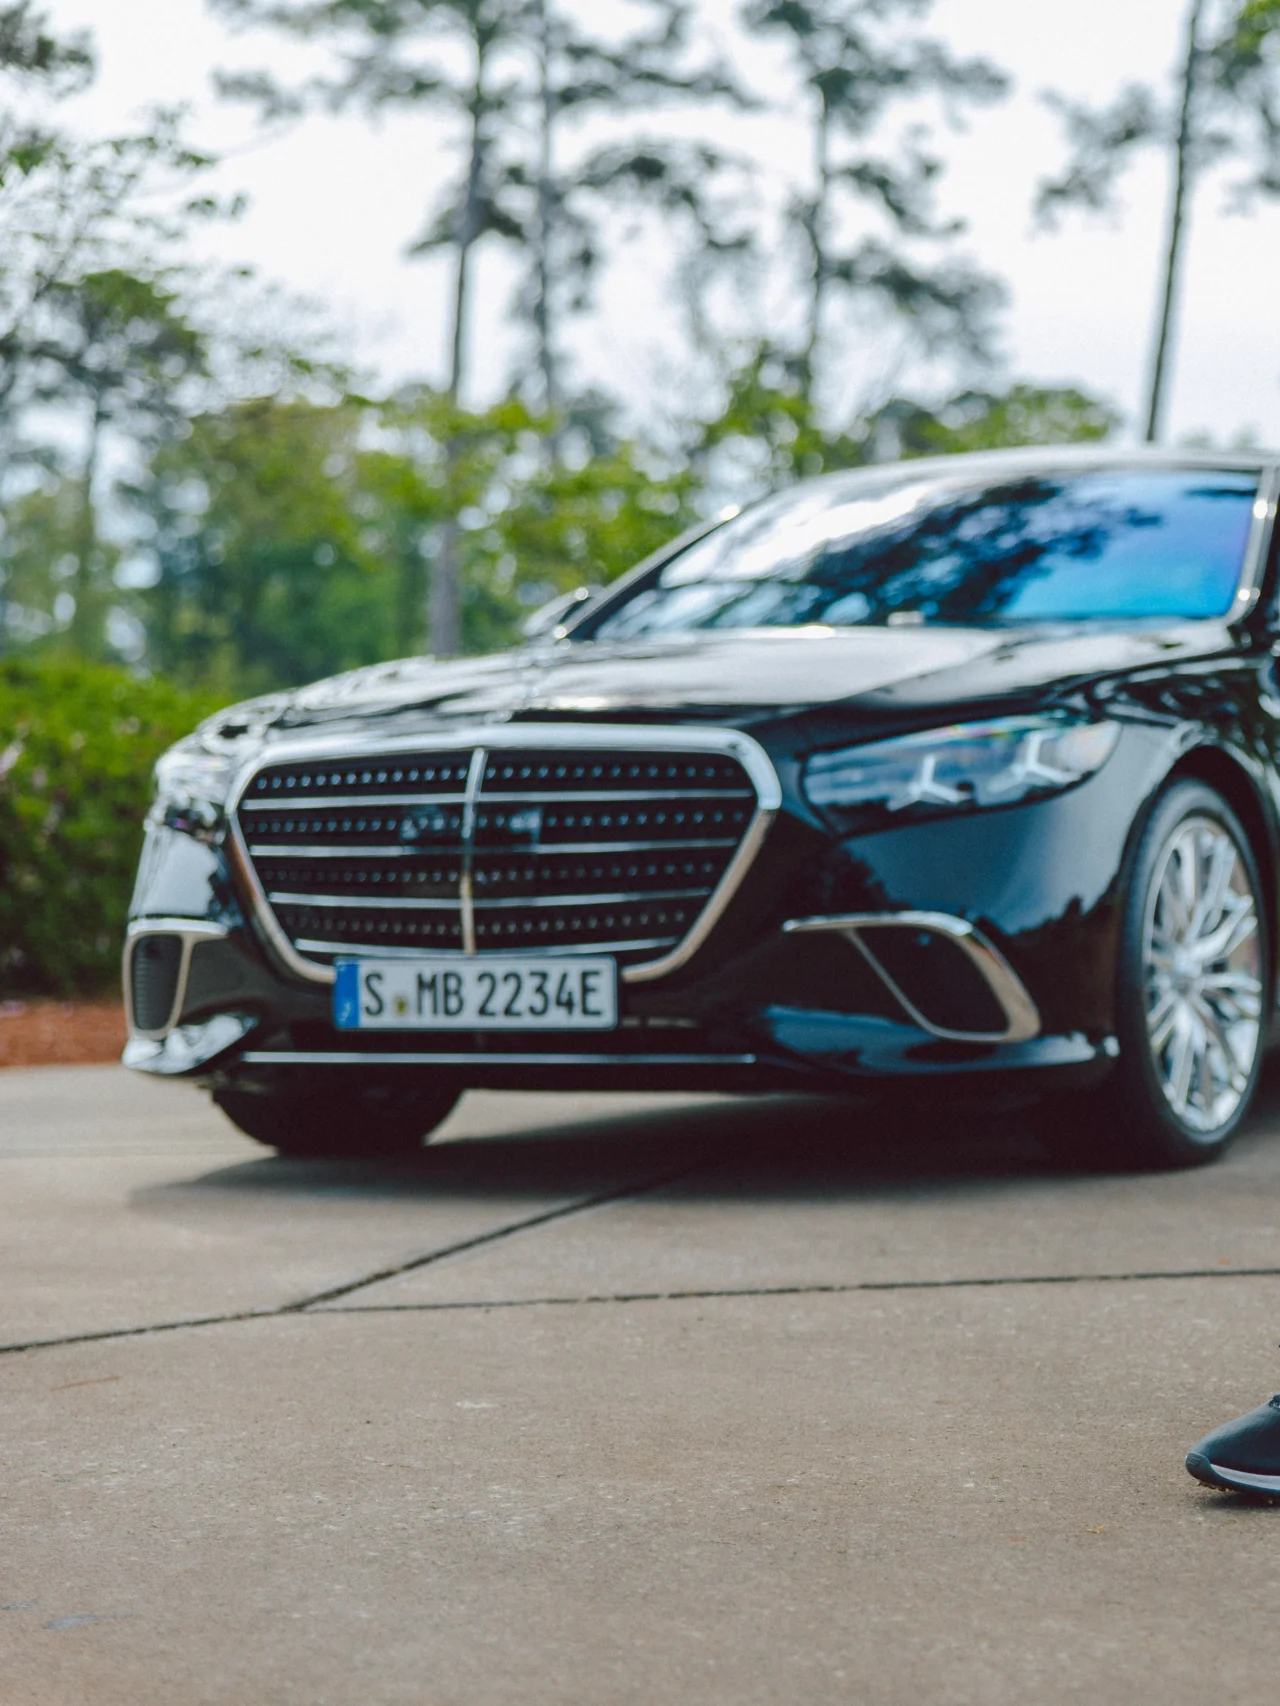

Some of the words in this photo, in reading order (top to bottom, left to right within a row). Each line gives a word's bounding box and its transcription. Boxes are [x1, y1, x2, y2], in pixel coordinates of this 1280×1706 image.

[364, 972, 384, 1017] S
[416, 971, 464, 1017] MB
[477, 971, 603, 1017] 2234E
